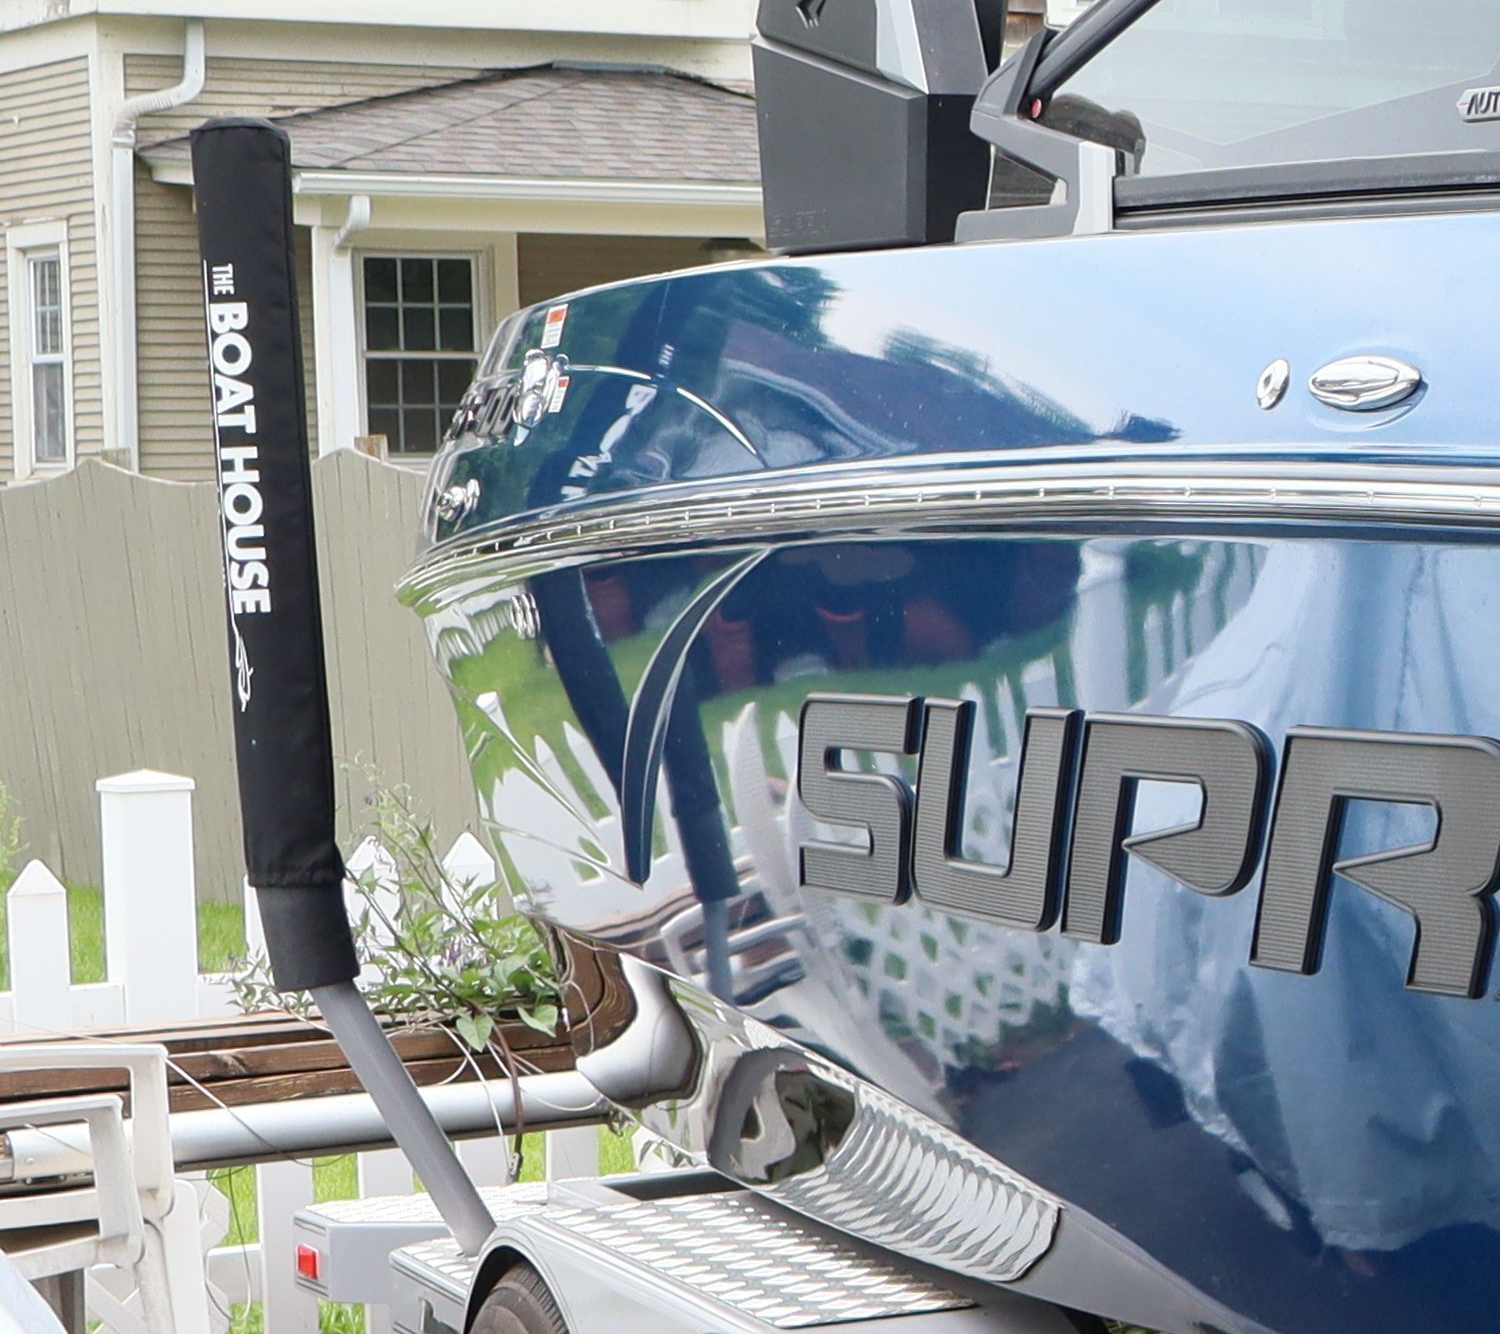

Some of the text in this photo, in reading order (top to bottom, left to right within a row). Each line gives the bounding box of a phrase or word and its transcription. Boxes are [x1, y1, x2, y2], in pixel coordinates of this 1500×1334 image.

[209, 263, 272, 614] THE BOAT HOUSE
